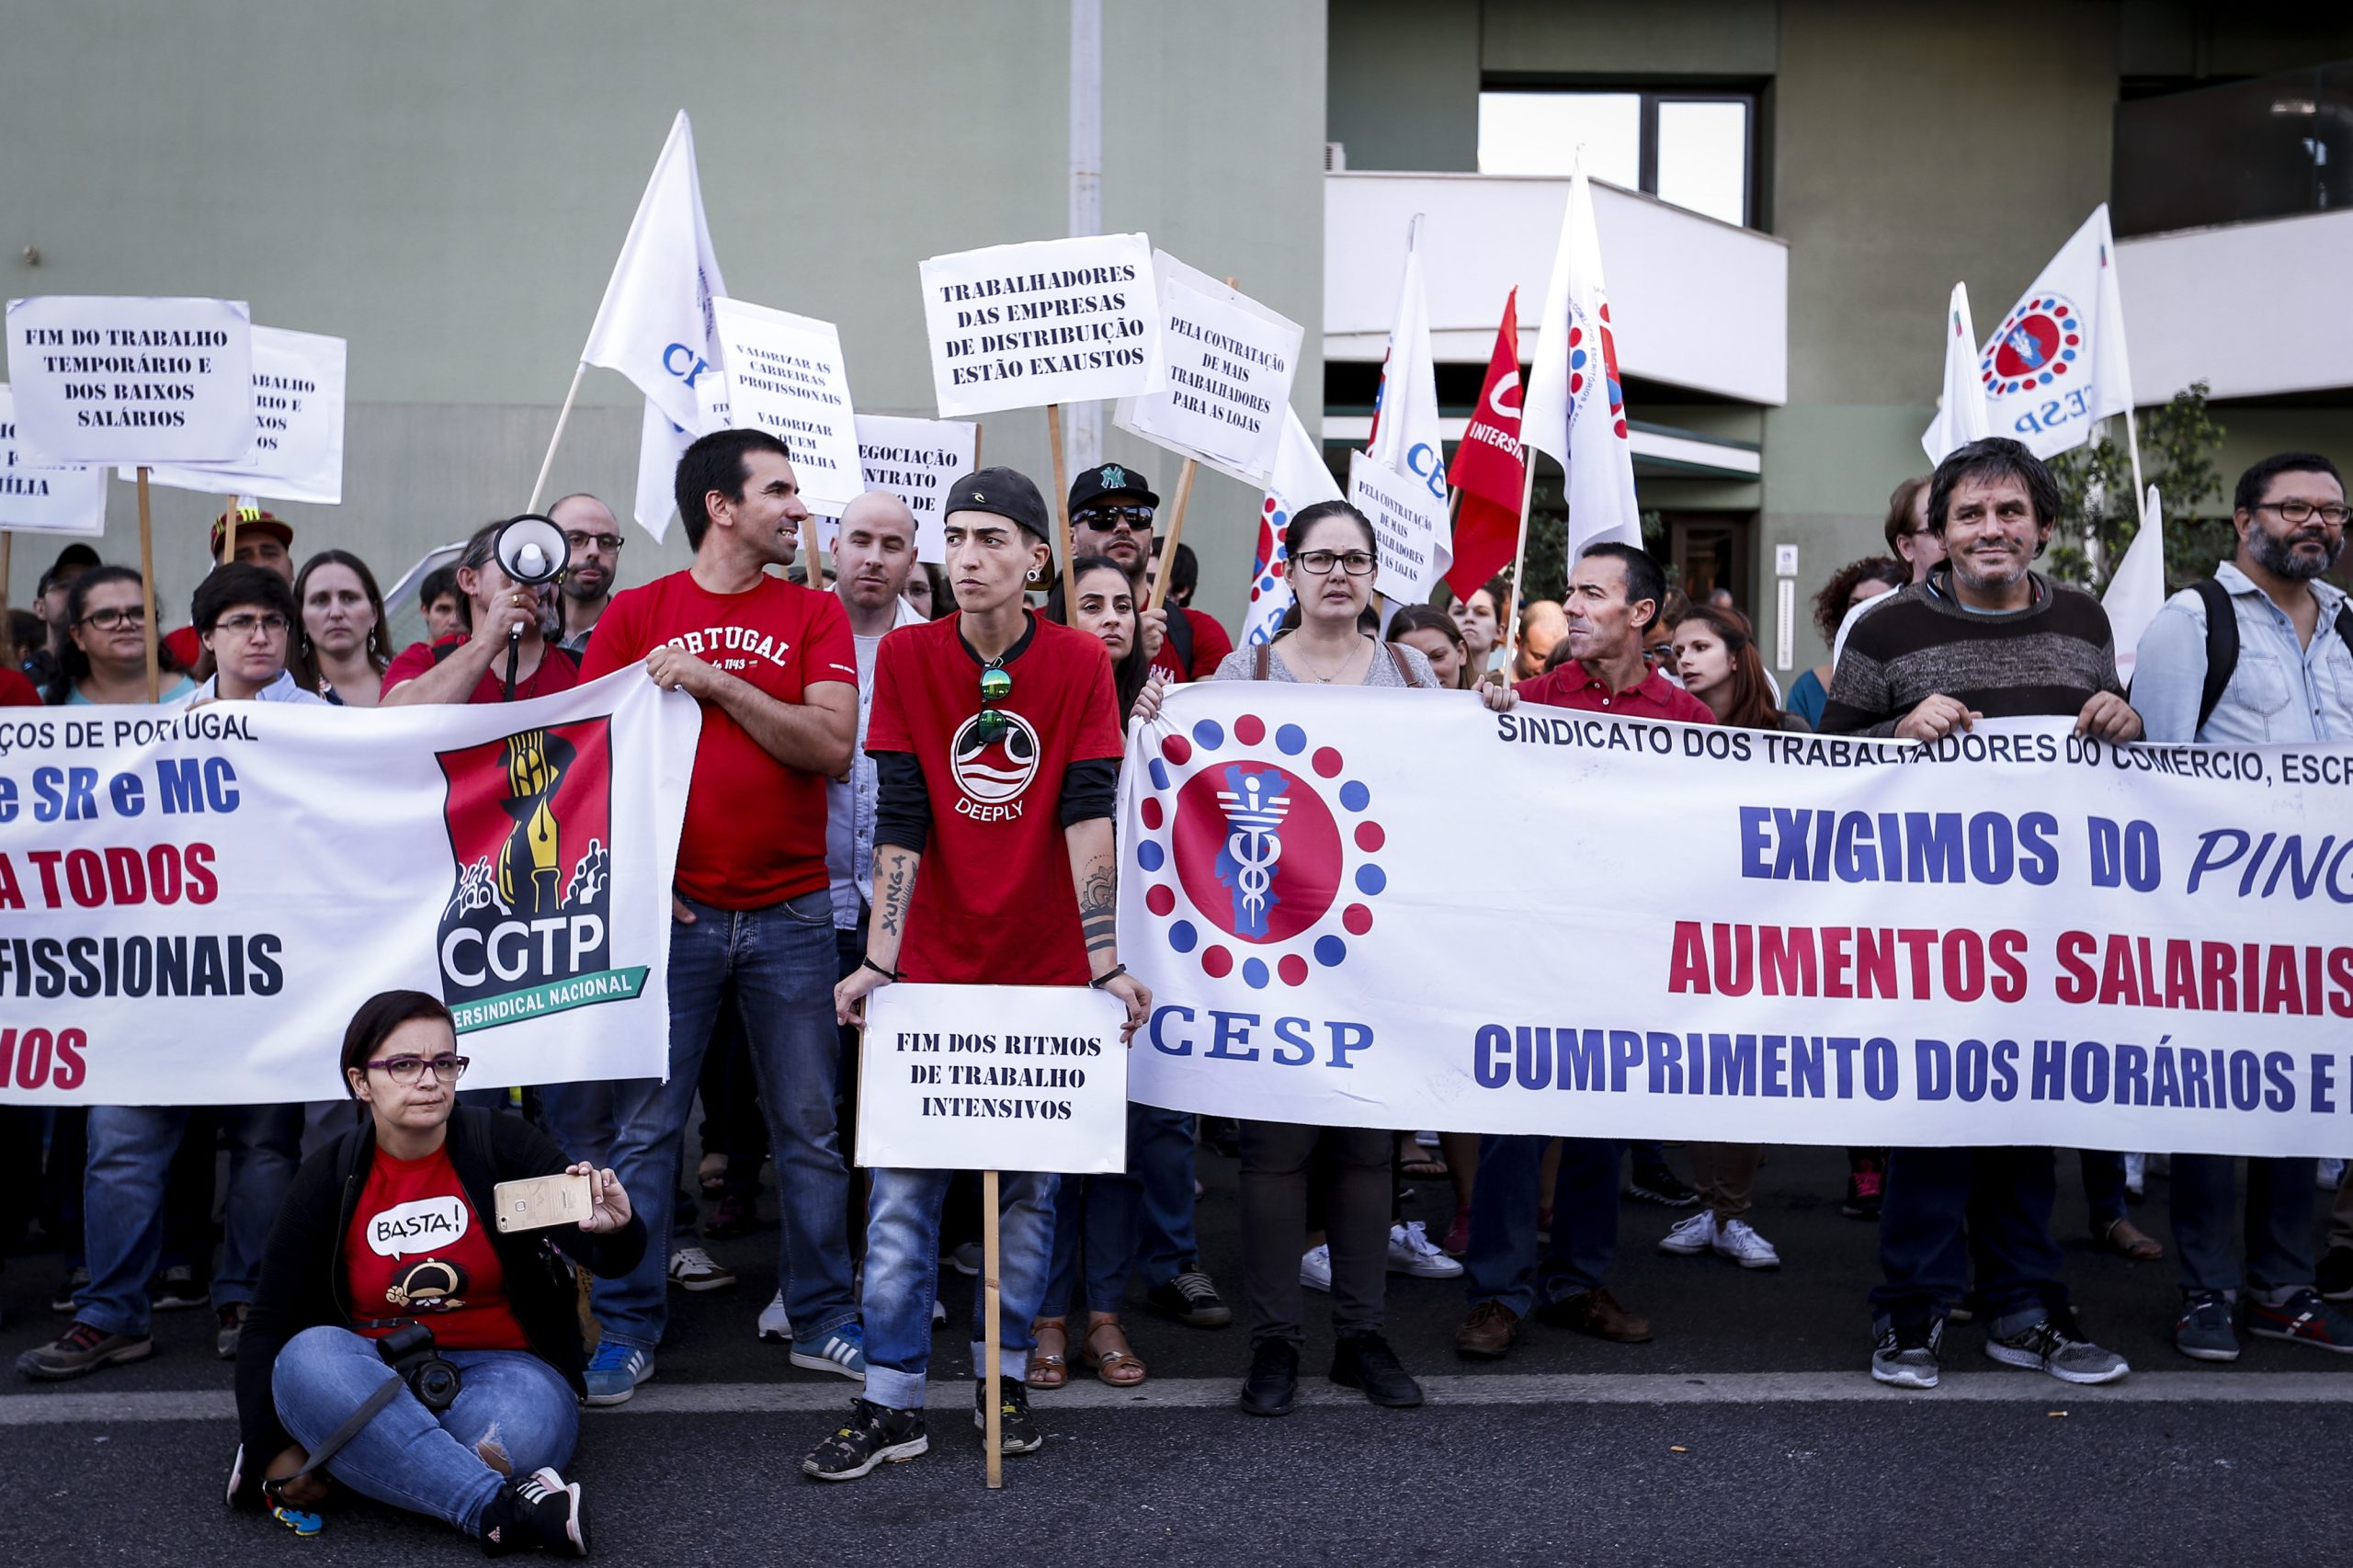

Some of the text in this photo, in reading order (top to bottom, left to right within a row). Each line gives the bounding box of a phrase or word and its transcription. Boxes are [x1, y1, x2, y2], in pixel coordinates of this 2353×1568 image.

[939, 264, 1136, 302] TRABALHADORES
[957, 292, 1126, 329] DAS EMPRESAS
[25, 329, 228, 347] FIM DO TRABALHO
[945, 317, 1144, 358] DE DISTRIBUIÇÃO
[1170, 315, 1285, 373] PELA CONTRATAÇÃO
[43, 353, 211, 373] TEMPORÁRIO E
[736, 344, 831, 374] VALORIZAR AS
[749, 361, 826, 387] CARREIRAS
[952, 347, 1144, 386] ESTÃO EXAUSTOS
[1202, 352, 1250, 382] DE MAIS
[65, 383, 195, 401] DOS BAIXOS
[257, 395, 301, 413] RIO E
[739, 374, 842, 406] PROFISSIONAIS
[1170, 365, 1271, 415] TRABALHADORES
[78, 406, 186, 428] SALÁRIOS
[256, 415, 287, 431] XOS
[757, 412, 833, 437] VALORIZAR
[1173, 391, 1261, 434] PARA AS LOJAS
[257, 437, 278, 449] OS
[0, 473, 49, 495] ÍLIA
[862, 468, 937, 489] NTRATO
[913, 496, 936, 512] DE
[1358, 481, 1432, 532] PELA CONTRATAÇÃO
[1380, 512, 1408, 538] DE MAIS
[1385, 555, 1393, 569] AS
[1395, 561, 1418, 582] LOJAS
[0, 713, 258, 756] ÇOS DE PORTUGAL
[1497, 713, 1673, 756] SINDICATO
[1684, 730, 1752, 761] DOS
[2066, 735, 2101, 767] DO
[32, 767, 98, 823] SR
[109, 772, 145, 817] e
[155, 756, 240, 814] MC
[955, 797, 1024, 822] DEEPLY
[1739, 806, 2060, 886] EXIGIMOS
[2087, 815, 2162, 893] DO
[27, 843, 218, 909] TODOS
[441, 914, 604, 987] CGTP
[1667, 920, 2029, 1004] AUMENTOS
[550, 974, 631, 1006] NACIONAL
[896, 1032, 1101, 1057] FIM DOS RITMOS
[1149, 1005, 1374, 1068] CESP
[911, 1064, 1086, 1089] DE TRABALHO
[1473, 1024, 1899, 1101] CUMPRIMENTO
[1915, 1038, 2020, 1102] DOS
[2030, 1034, 2296, 1113] HORÁRIOS
[2310, 1052, 2336, 1114] E
[922, 1096, 1072, 1120] INTENSIVOS
[378, 1204, 460, 1243] BASTA!
